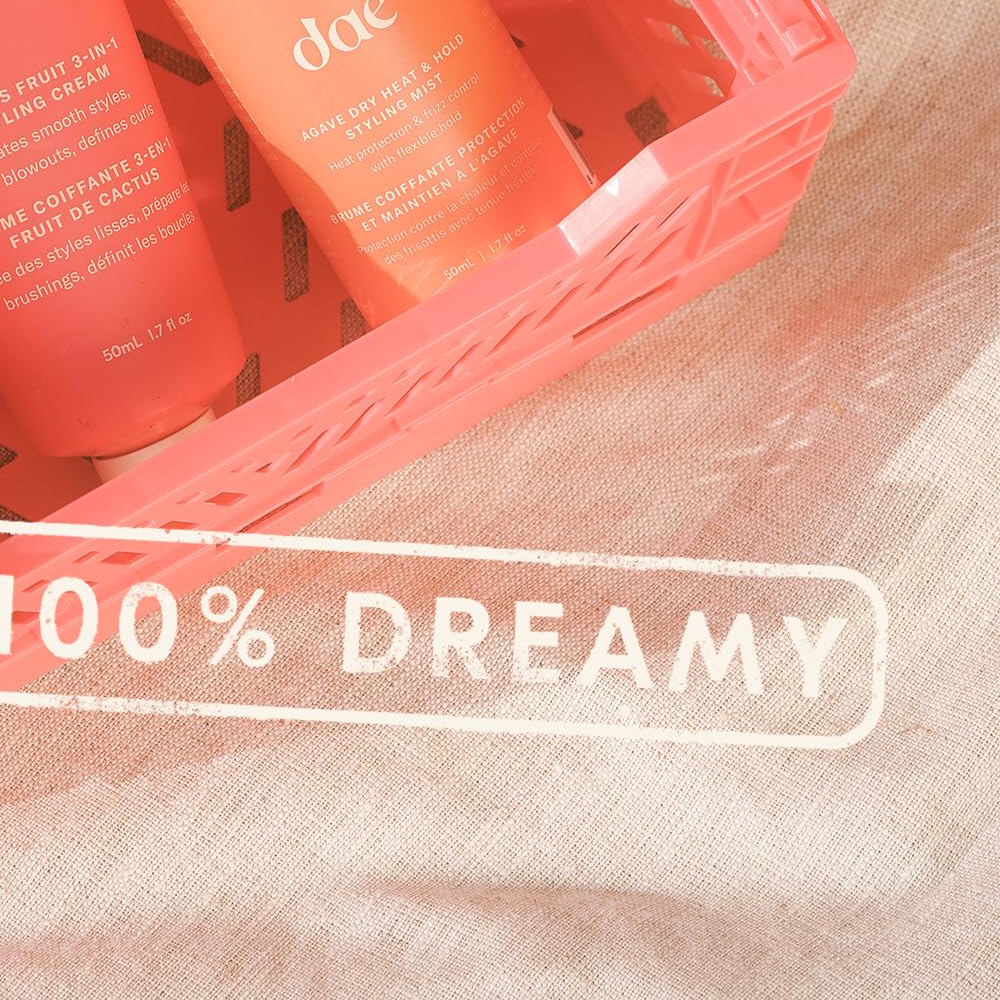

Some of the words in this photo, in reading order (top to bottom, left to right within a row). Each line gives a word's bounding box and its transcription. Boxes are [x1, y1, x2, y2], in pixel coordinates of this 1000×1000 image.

[15, 61, 66, 95] FRUIT
[71, 37, 119, 69] 3-IN-1
[51, 64, 111, 101] CREAM
[301, 114, 346, 142] AGAVE
[348, 95, 377, 119] DRY
[381, 68, 417, 100] HEAT
[421, 61, 432, 73] &
[432, 33, 465, 64] HOLD
[32, 108, 87, 142] smooth
[89, 87, 131, 115] styles,
[328, 155, 354, 173] Heat
[356, 122, 413, 162] protection
[412, 115, 424, 127] &
[423, 99, 447, 120] frizz
[448, 71, 481, 103] control
[345, 99, 408, 140] STYLING
[410, 72, 444, 102] MIST
[370, 154, 396, 173] with
[397, 130, 438, 159] flexible
[439, 111, 463, 133] hold
[2, 149, 76, 187] blowouts,
[78, 120, 128, 151] defines
[130, 103, 155, 125] curls
[33, 159, 131, 214] COIFFANTE
[133, 136, 172, 166] 3-EN-1
[329, 201, 373, 225] BRUME
[375, 156, 456, 207] COIFFANTE
[457, 97, 527, 159] PROTECTION
[9, 214, 63, 249] FRUIT
[69, 201, 94, 221] DE
[98, 167, 160, 206] CACTUS
[15, 256, 44, 277] des
[46, 235, 92, 262] styles
[94, 213, 140, 241] lisses,
[141, 189, 181, 220] prépare
[361, 218, 378, 232] ET
[381, 178, 453, 224] MAINTIEN
[384, 251, 404, 265] des
[403, 231, 447, 258] frisottis
[448, 212, 475, 233] avec
[476, 190, 505, 216] tenue
[409, 209, 446, 234] contre
[447, 201, 458, 214] la
[460, 174, 498, 206] chaleur
[500, 165, 512, 177] et
[3, 271, 85, 311] brushings,
[87, 243, 136, 276] définit
[136, 232, 157, 251] les
[157, 210, 196, 239] boucles
[443, 257, 475, 280] 50mL
[102, 335, 143, 363] 50mL
[167, 318, 176, 332] fl
[178, 312, 193, 325] oz
